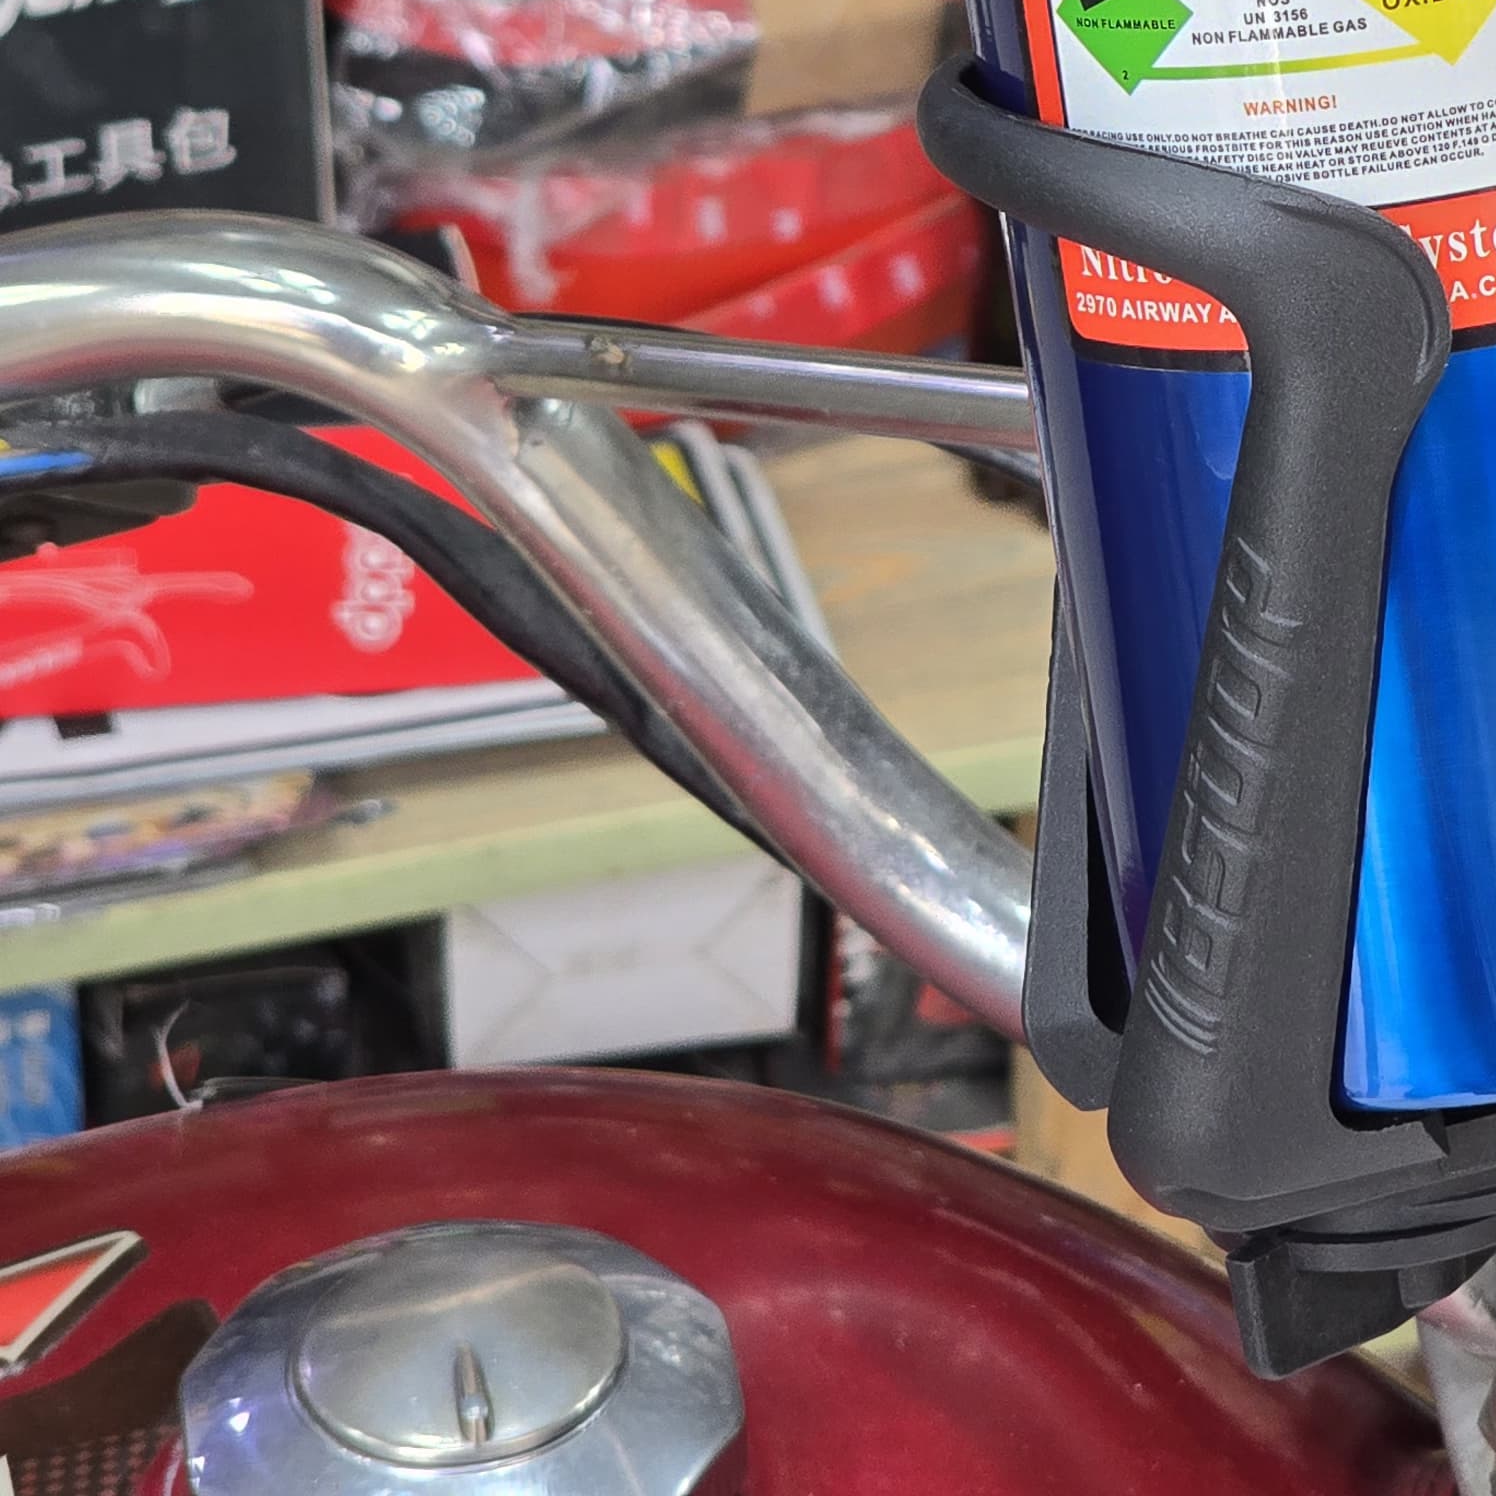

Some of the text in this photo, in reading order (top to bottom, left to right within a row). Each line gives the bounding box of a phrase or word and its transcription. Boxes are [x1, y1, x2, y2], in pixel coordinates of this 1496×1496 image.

[1076, 16, 1176, 30] NON FLAMMABLE
[1243, 8, 1309, 25] UN 3156
[1192, 17, 1368, 45] NON FLAMMABLE GAS
[1122, 70, 1129, 80] 2
[1243, 95, 1338, 116] WARNING!
[1126, 132, 1144, 141] USE
[1192, 133, 1213, 142] NOT
[1216, 131, 1267, 141] BREATHE
[1297, 124, 1336, 137] CAUSE
[1400, 112, 1425, 124] NOT
[1427, 104, 1468, 119] ALLOW
[1470, 102, 1484, 113] TO
[1195, 142, 1257, 153] FROSTBITE
[1260, 141, 1282, 151] FOR
[1285, 137, 1311, 150] THIS
[1314, 133, 1362, 145] REASON
[1365, 130, 1388, 141] USE
[1391, 122, 1443, 137] CAUTION
[1445, 113, 1479, 127] WHEN
[1247, 152, 1275, 163] DISC
[1277, 151, 1294, 161] ON
[1296, 146, 1331, 159] VALVE
[1334, 142, 1358, 155] MAY
[1411, 125, 1472, 145] CONTENTS
[1474, 123, 1488, 134] AT
[1296, 159, 1326, 172] HEAT
[1328, 157, 1345, 168] OR
[1348, 152, 1387, 166] STORE
[1389, 145, 1429, 160] ABOVE
[1433, 142, 1450, 154] 120
[1313, 166, 1359, 180] BOTTLE
[1361, 160, 1412, 175] FAILURE
[1414, 155, 1437, 168] CAN
[1076, 292, 1117, 317] 2970
[1121, 298, 1212, 324] AIRWAY
